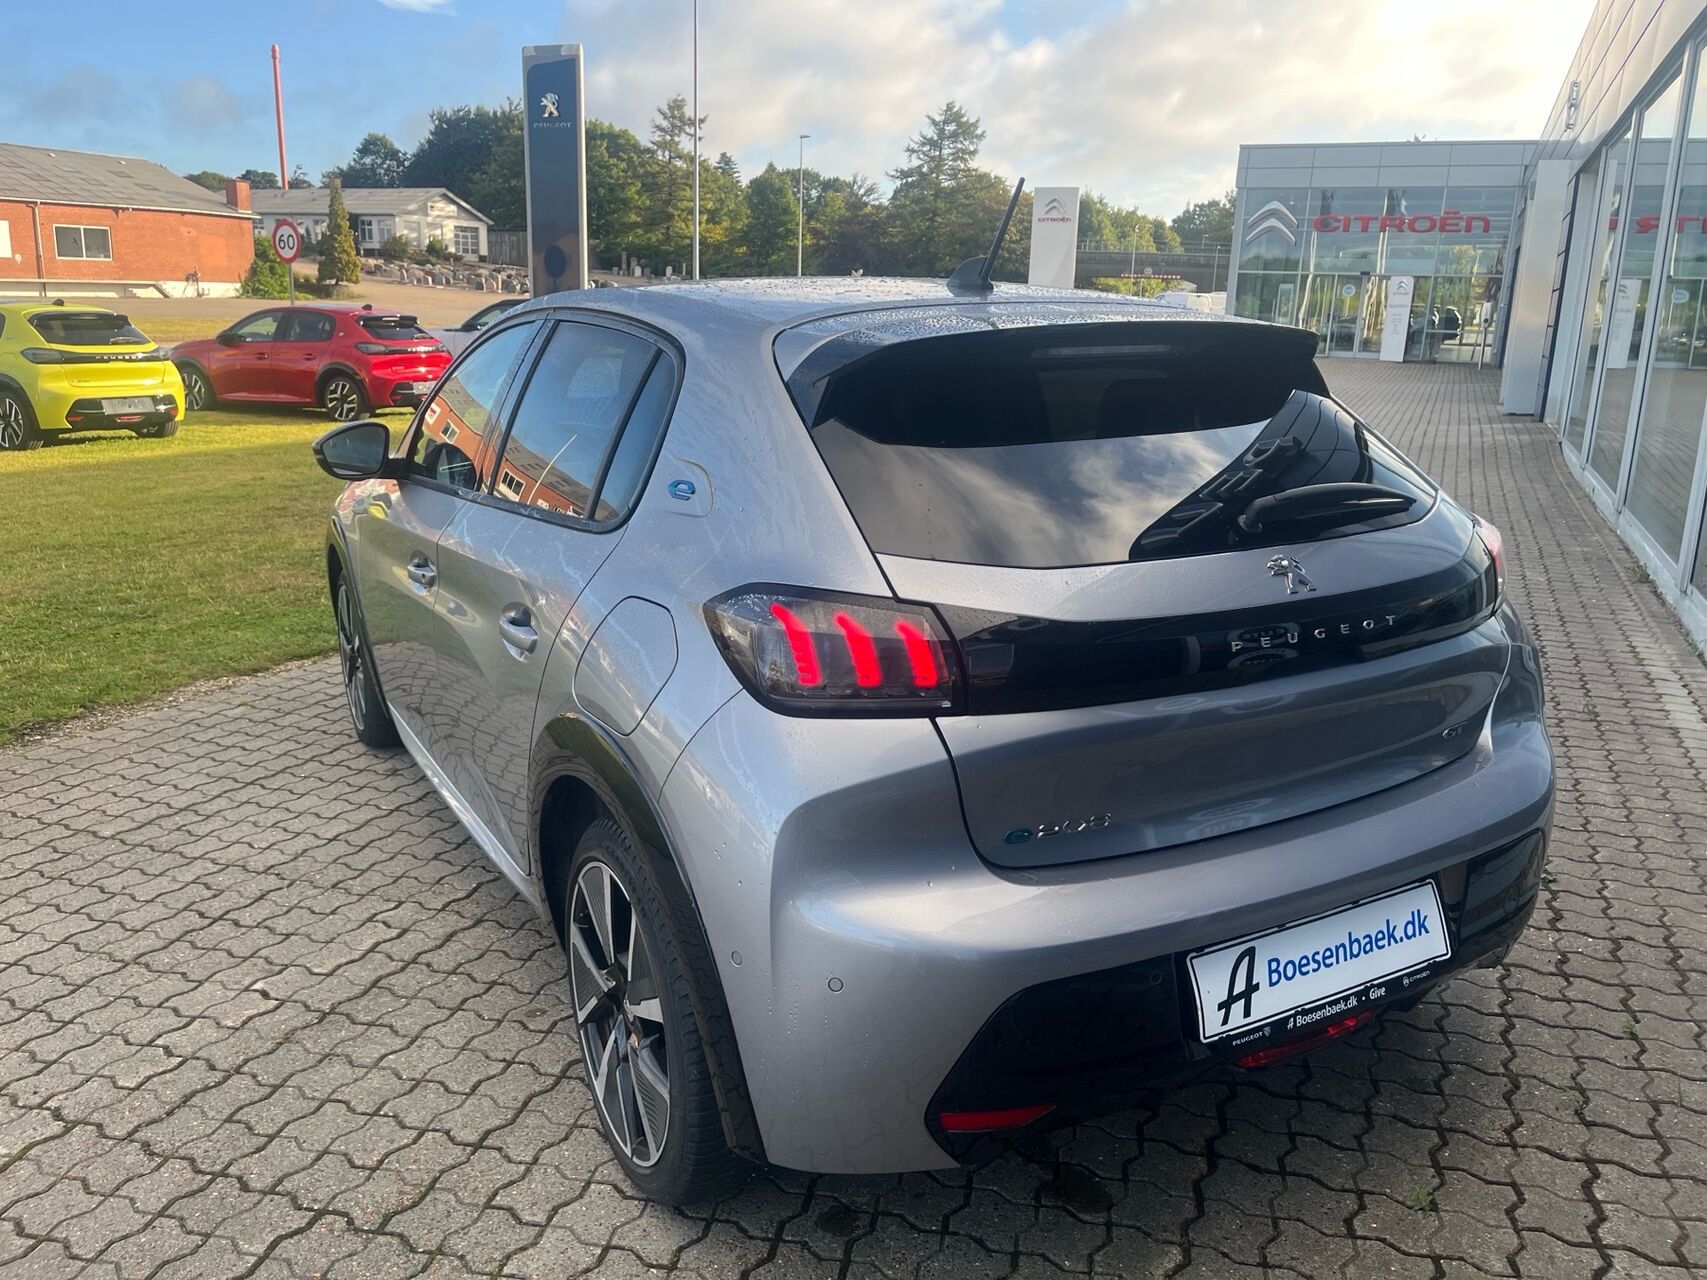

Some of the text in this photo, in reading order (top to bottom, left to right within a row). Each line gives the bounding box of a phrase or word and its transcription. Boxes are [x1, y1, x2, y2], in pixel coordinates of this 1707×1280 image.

[278, 233, 295, 250] 60
[1231, 615, 1396, 652] PEUGEOT
[1267, 909, 1430, 988] Boesenbaek.dk
[1296, 996, 1358, 1027] Boesenbaek.dk
[1369, 986, 1386, 1000] Give
[1232, 1031, 1263, 1046] PEUGEOT
